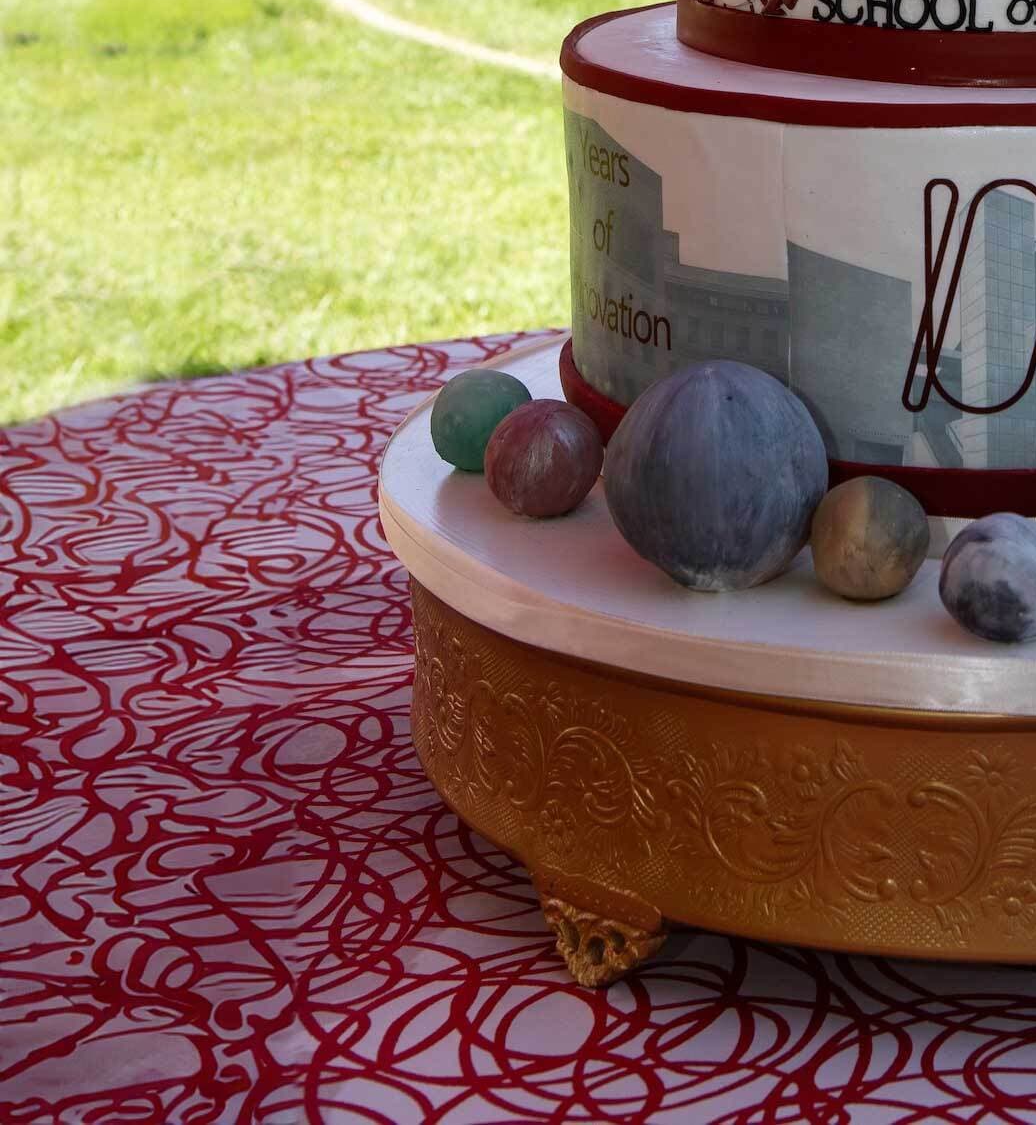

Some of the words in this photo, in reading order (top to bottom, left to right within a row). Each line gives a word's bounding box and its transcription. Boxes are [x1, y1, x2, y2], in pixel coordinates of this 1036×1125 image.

[579, 127, 630, 188] Years
[592, 210, 614, 255] of
[586, 285, 672, 351] ovation
